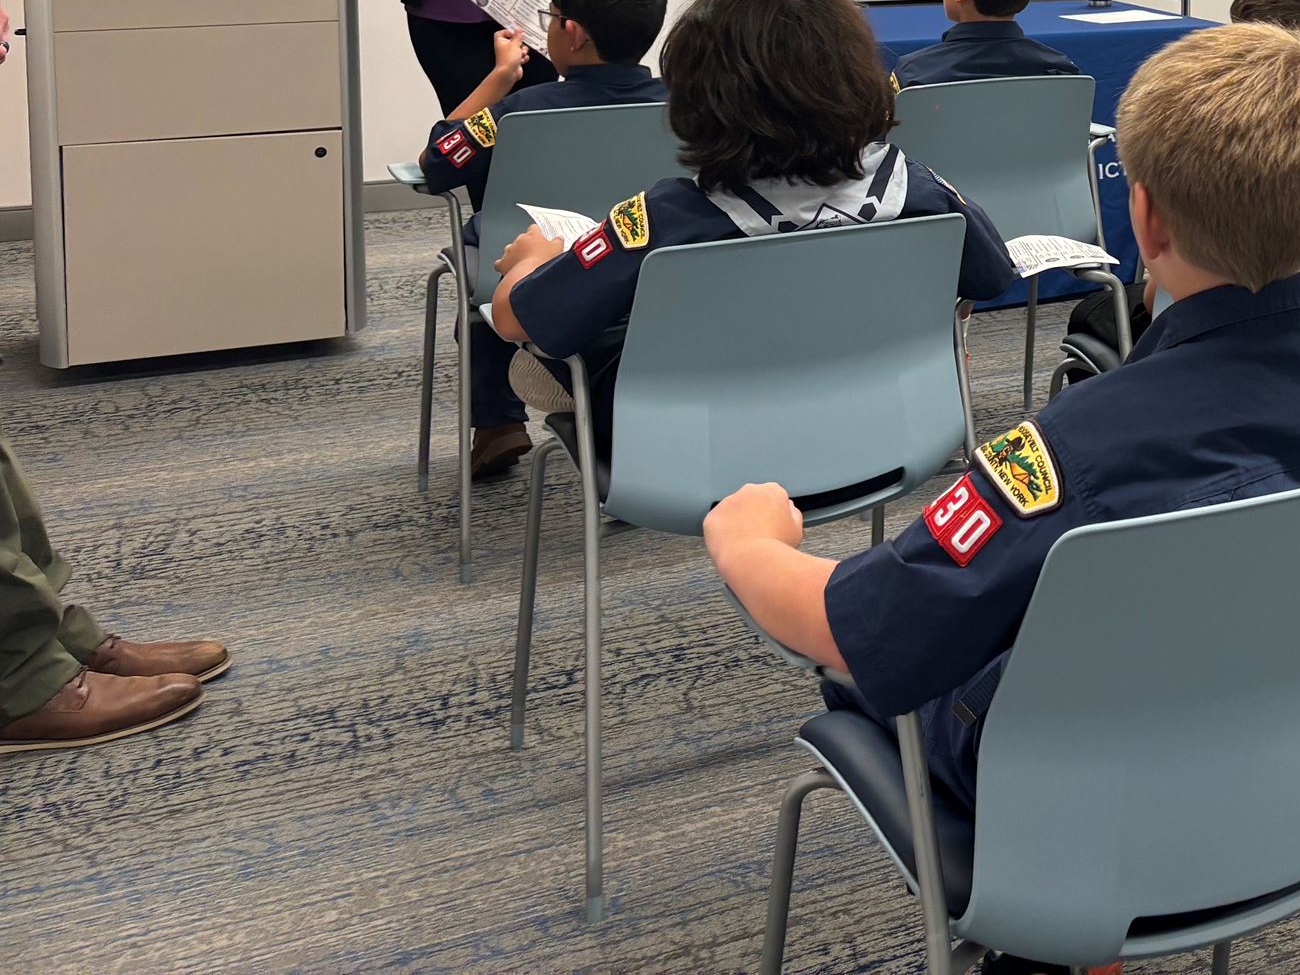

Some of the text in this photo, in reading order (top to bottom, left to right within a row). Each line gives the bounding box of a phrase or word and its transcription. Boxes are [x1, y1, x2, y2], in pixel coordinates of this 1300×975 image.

[998, 469, 1012, 486] NEW
[1010, 485, 1029, 507] YORK
[1035, 454, 1053, 495] COUNCIL
